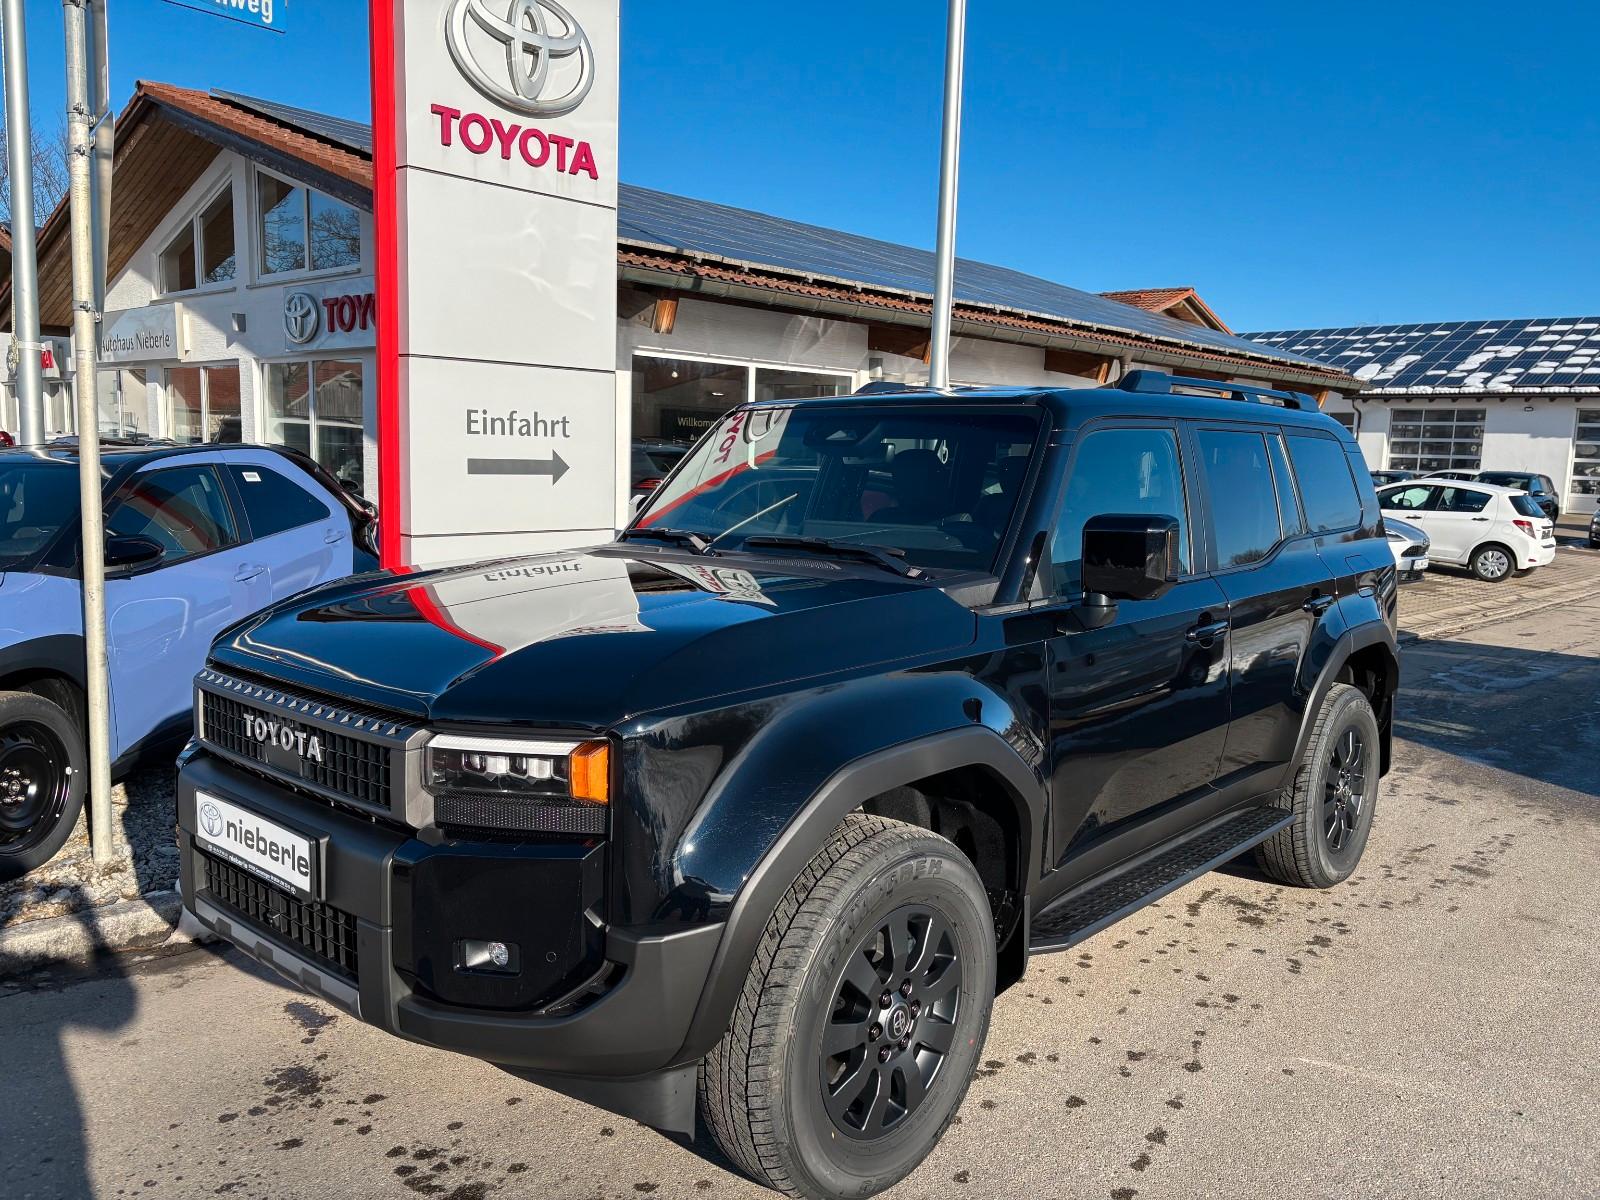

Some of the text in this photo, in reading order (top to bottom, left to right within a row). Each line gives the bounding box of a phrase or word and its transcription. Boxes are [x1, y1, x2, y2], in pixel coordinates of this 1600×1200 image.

[431, 103, 599, 181] TOYOTA
[322, 293, 377, 333] TOY
[135, 329, 171, 351] Nieberle
[466, 408, 571, 439] Einfahrt
[243, 713, 322, 763] TOYOTA
[226, 818, 310, 878] nieberle
